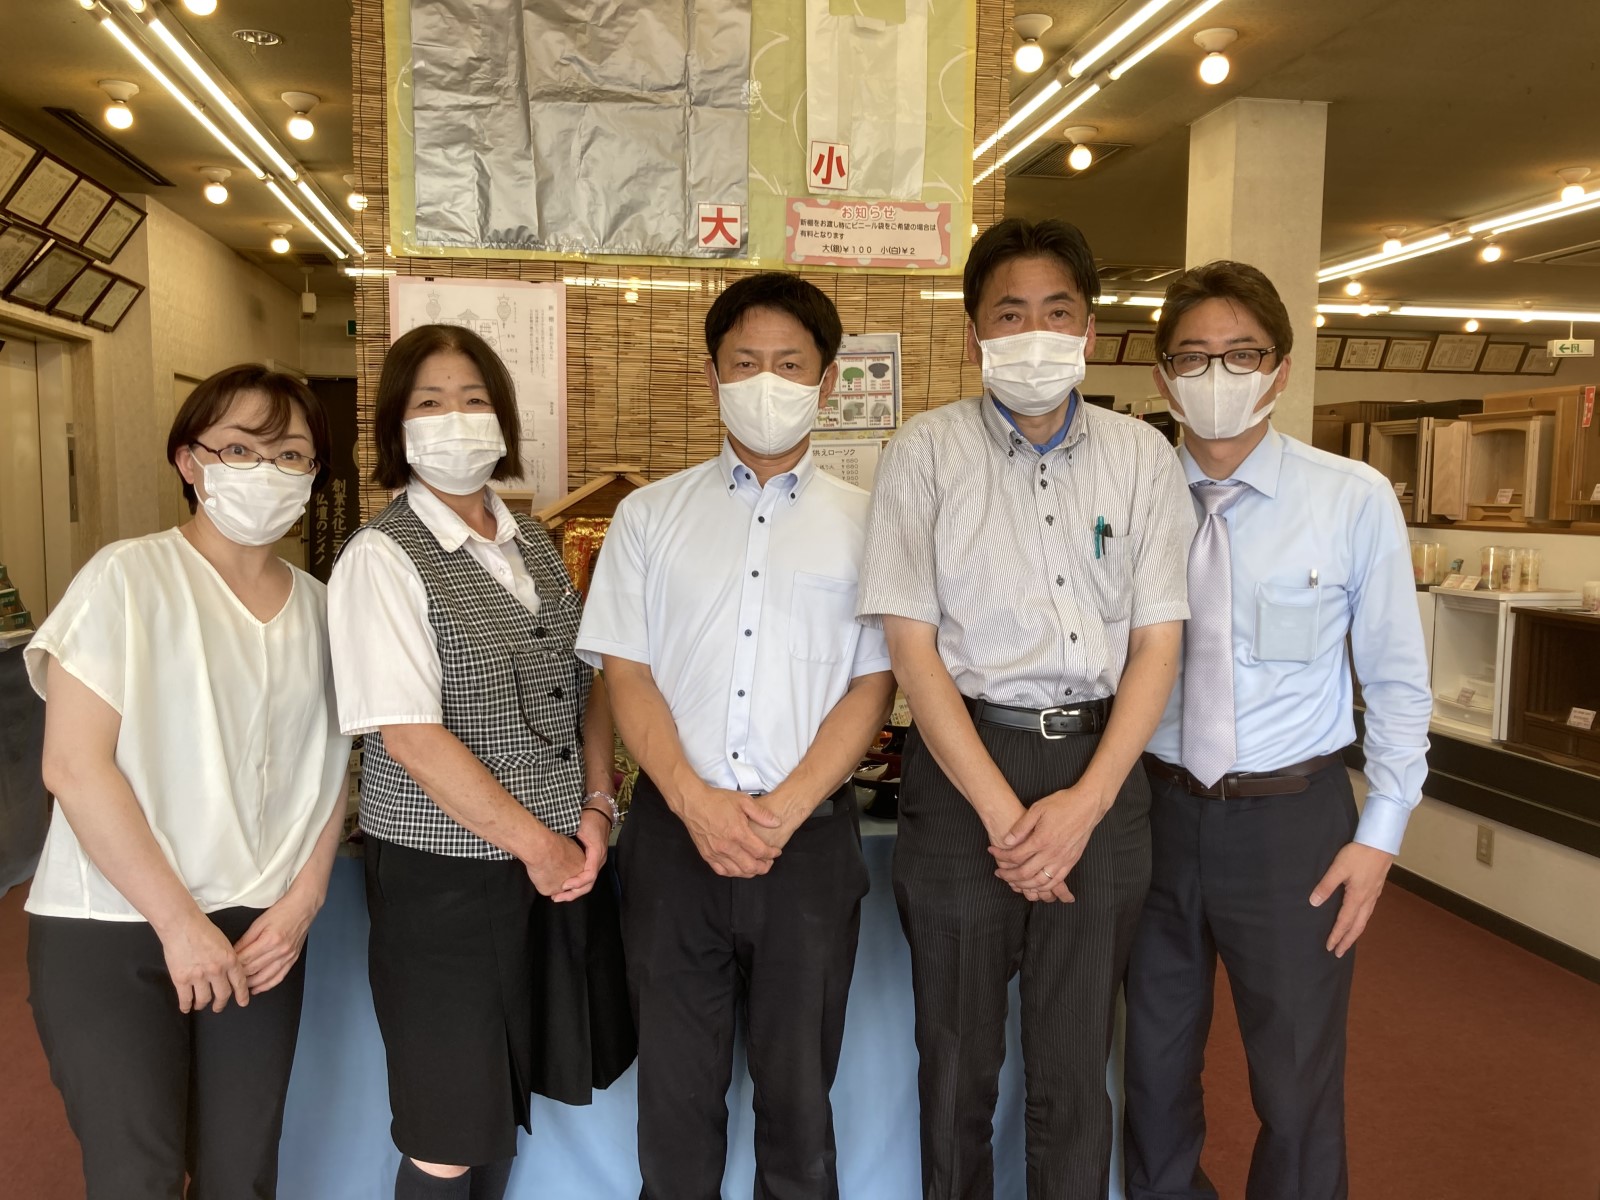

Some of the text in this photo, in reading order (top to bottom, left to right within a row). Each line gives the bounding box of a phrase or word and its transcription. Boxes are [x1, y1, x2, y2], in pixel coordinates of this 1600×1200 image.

[812, 146, 846, 185] 小
[841, 206, 895, 220] お知らせ
[701, 207, 738, 246] 大
[800, 230, 845, 240] 有料となります
